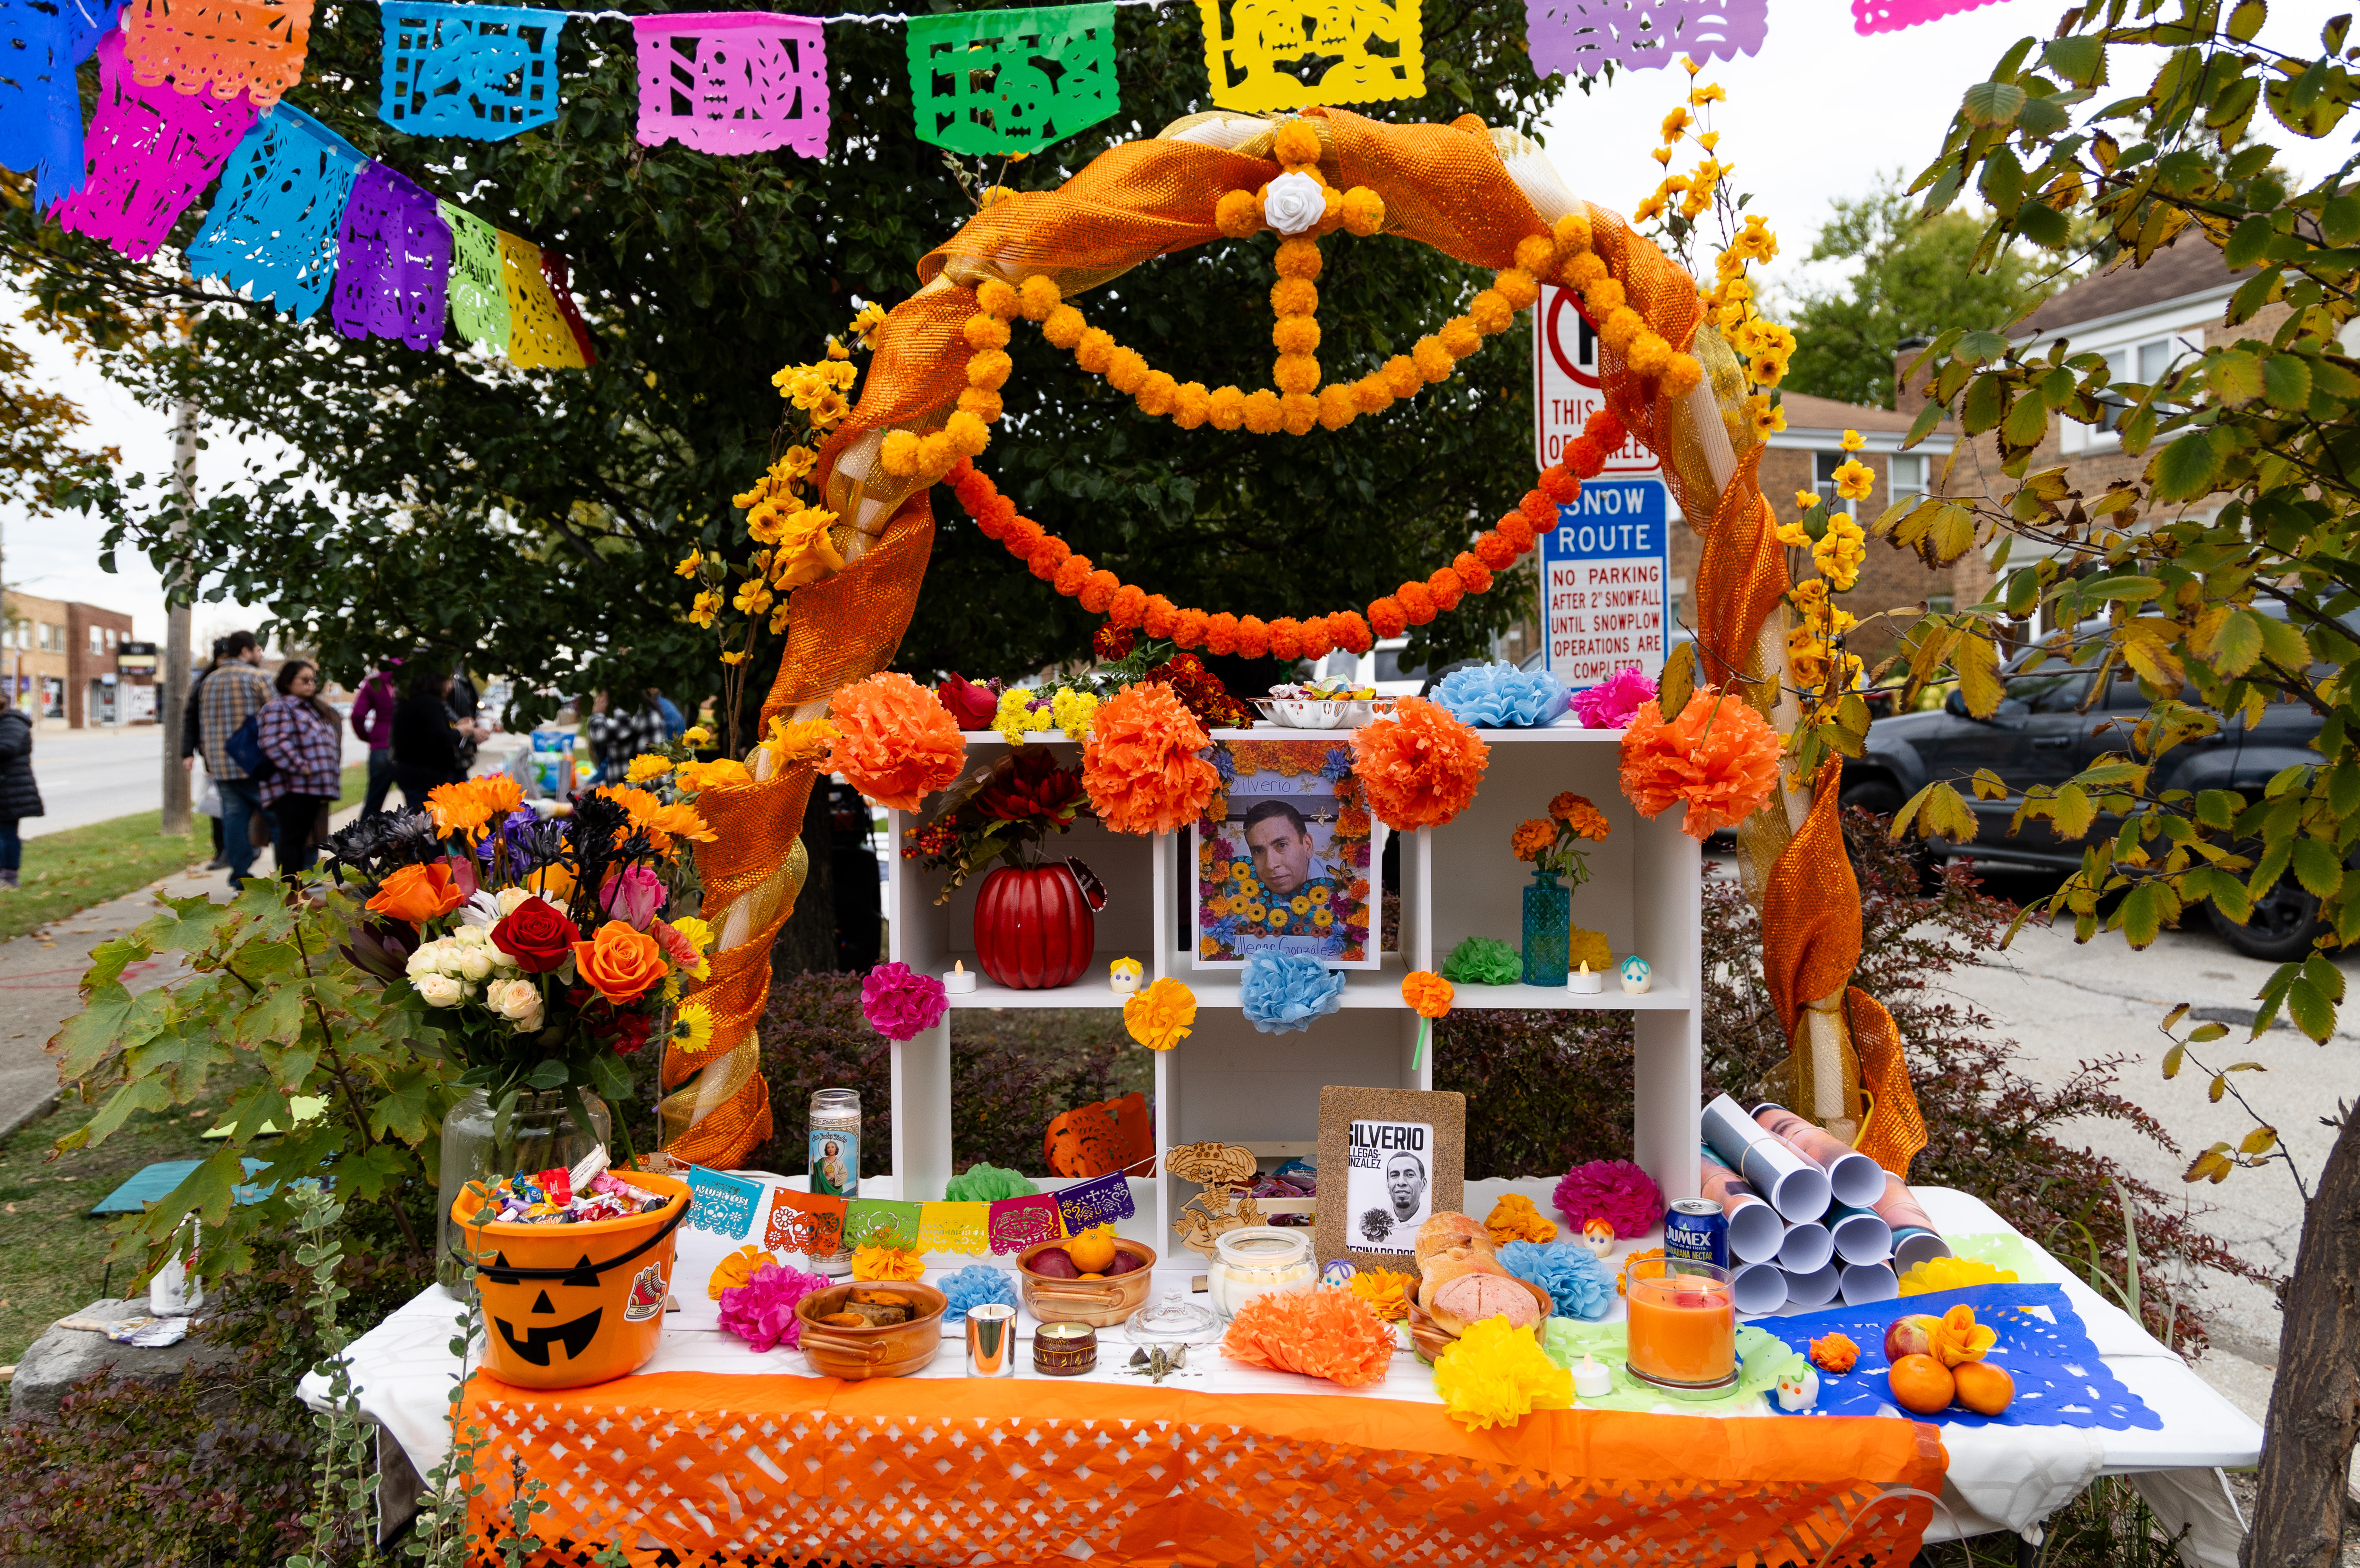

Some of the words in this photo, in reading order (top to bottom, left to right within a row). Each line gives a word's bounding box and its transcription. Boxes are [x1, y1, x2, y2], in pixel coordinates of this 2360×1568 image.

[1559, 524, 1651, 553] ROUTE
[1553, 570, 1575, 586] NO
[1589, 566, 1659, 585] PARKING
[1552, 592, 1585, 610] AFTER
[1606, 589, 1661, 608] SNOWFALL
[1551, 616, 1585, 634] UNTIL
[1594, 612, 1660, 631] SNOWPLOW
[1554, 637, 1629, 657] OPERATIONS
[1637, 635, 1661, 652] ARE
[819, 1132, 833, 1140] Judas
[695, 1183, 749, 1206] MUERTOS
[1666, 1225, 1711, 1246] JUMEX
[1692, 1251, 1713, 1261] NECTAR
